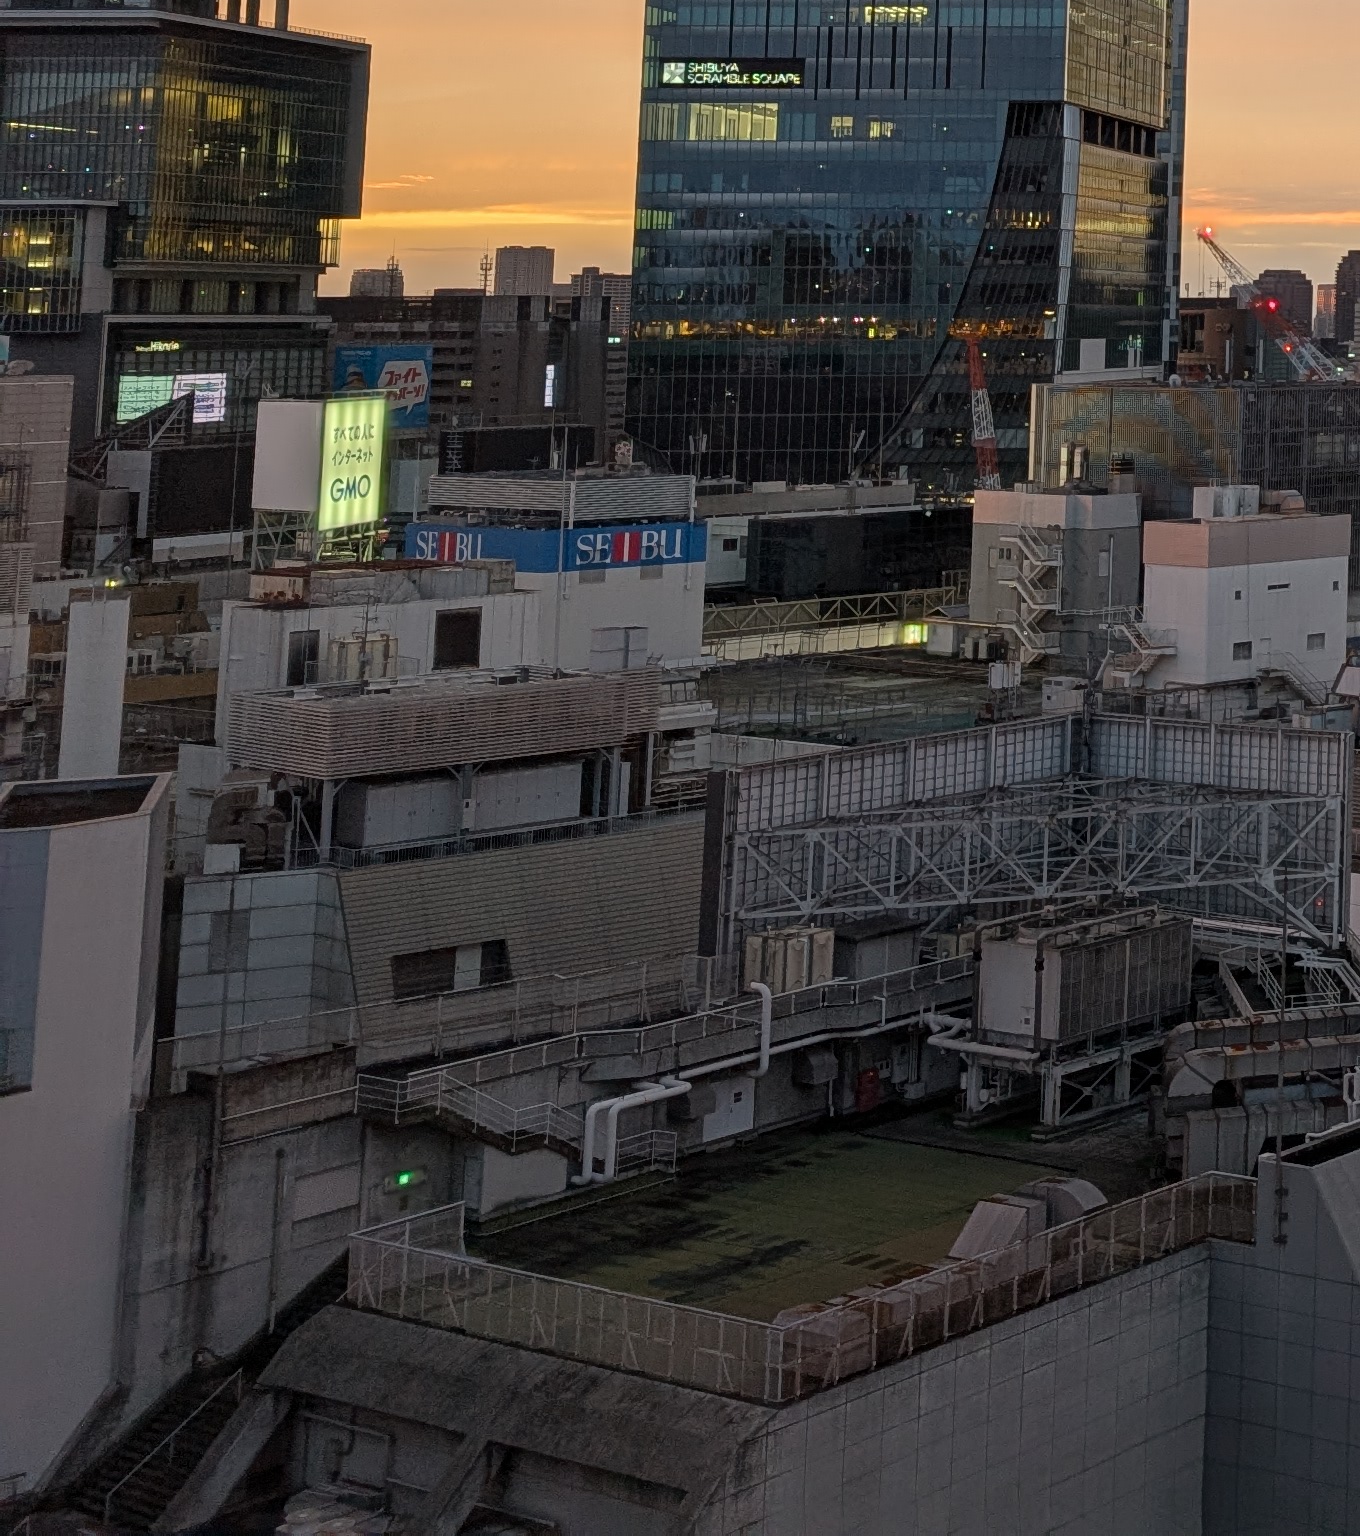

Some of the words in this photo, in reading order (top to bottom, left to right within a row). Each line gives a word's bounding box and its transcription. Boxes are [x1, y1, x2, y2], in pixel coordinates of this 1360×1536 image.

[687, 62, 740, 73] SHIBUYA
[687, 73, 750, 84] SCRAMBLE
[752, 73, 801, 84] SQUARE
[385, 367, 422, 387] ファイト
[333, 424, 375, 443] すべての人に
[332, 446, 374, 466] インターネット
[330, 474, 371, 502] GMO
[416, 530, 482, 562] SEIBU
[576, 529, 683, 565] SEIBU
